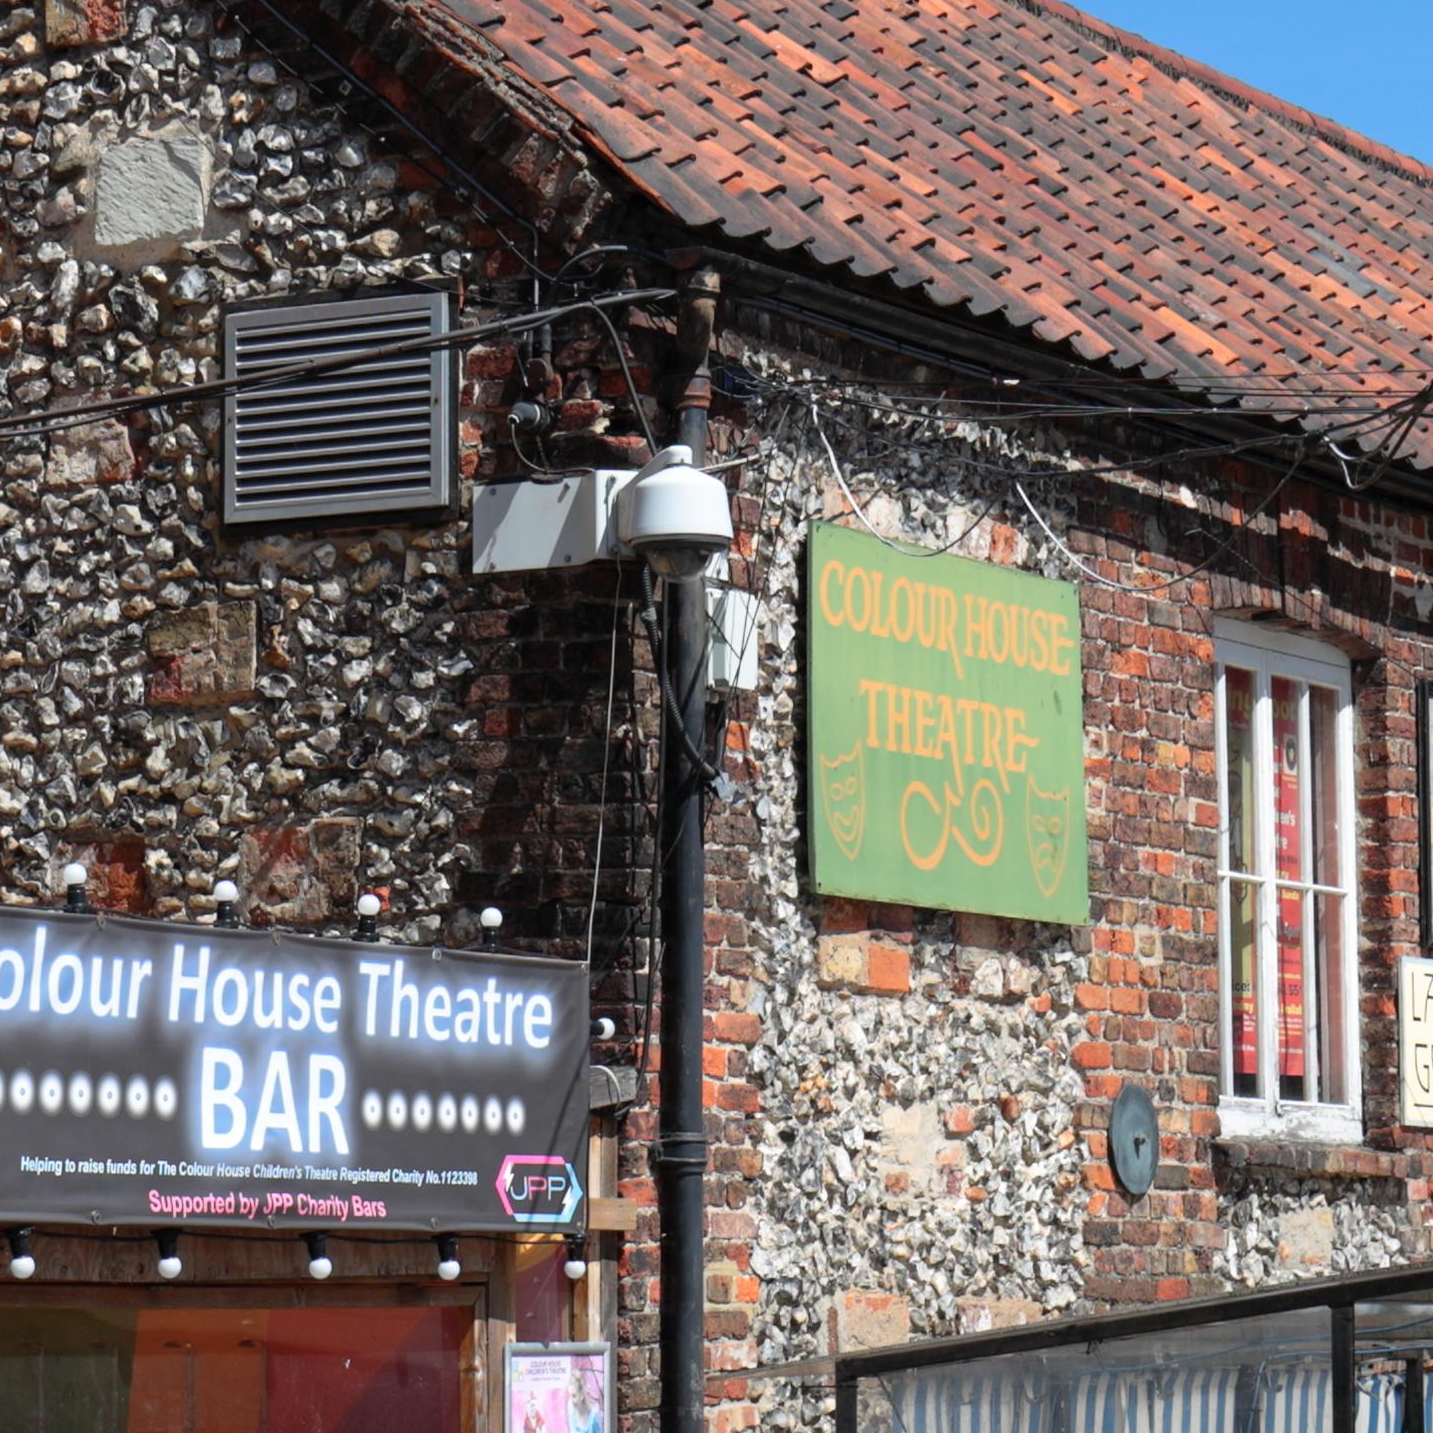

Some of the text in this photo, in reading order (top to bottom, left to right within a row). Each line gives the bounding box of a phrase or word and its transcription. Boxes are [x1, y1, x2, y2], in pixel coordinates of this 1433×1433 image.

[819, 560, 1074, 679] COLOUR HOUSE
[860, 680, 1039, 796] THEATRE
[168, 943, 340, 1033] House
[360, 961, 553, 1049] Theatre
[200, 1047, 350, 1155] BAR
[21, 1157, 424, 1187] Helping to raise funds for The Colour House Children's Theatre Registered Charity
[148, 1189, 387, 1221] Supported by JPP Charity Bars
[510, 1176, 565, 1201] JPP
